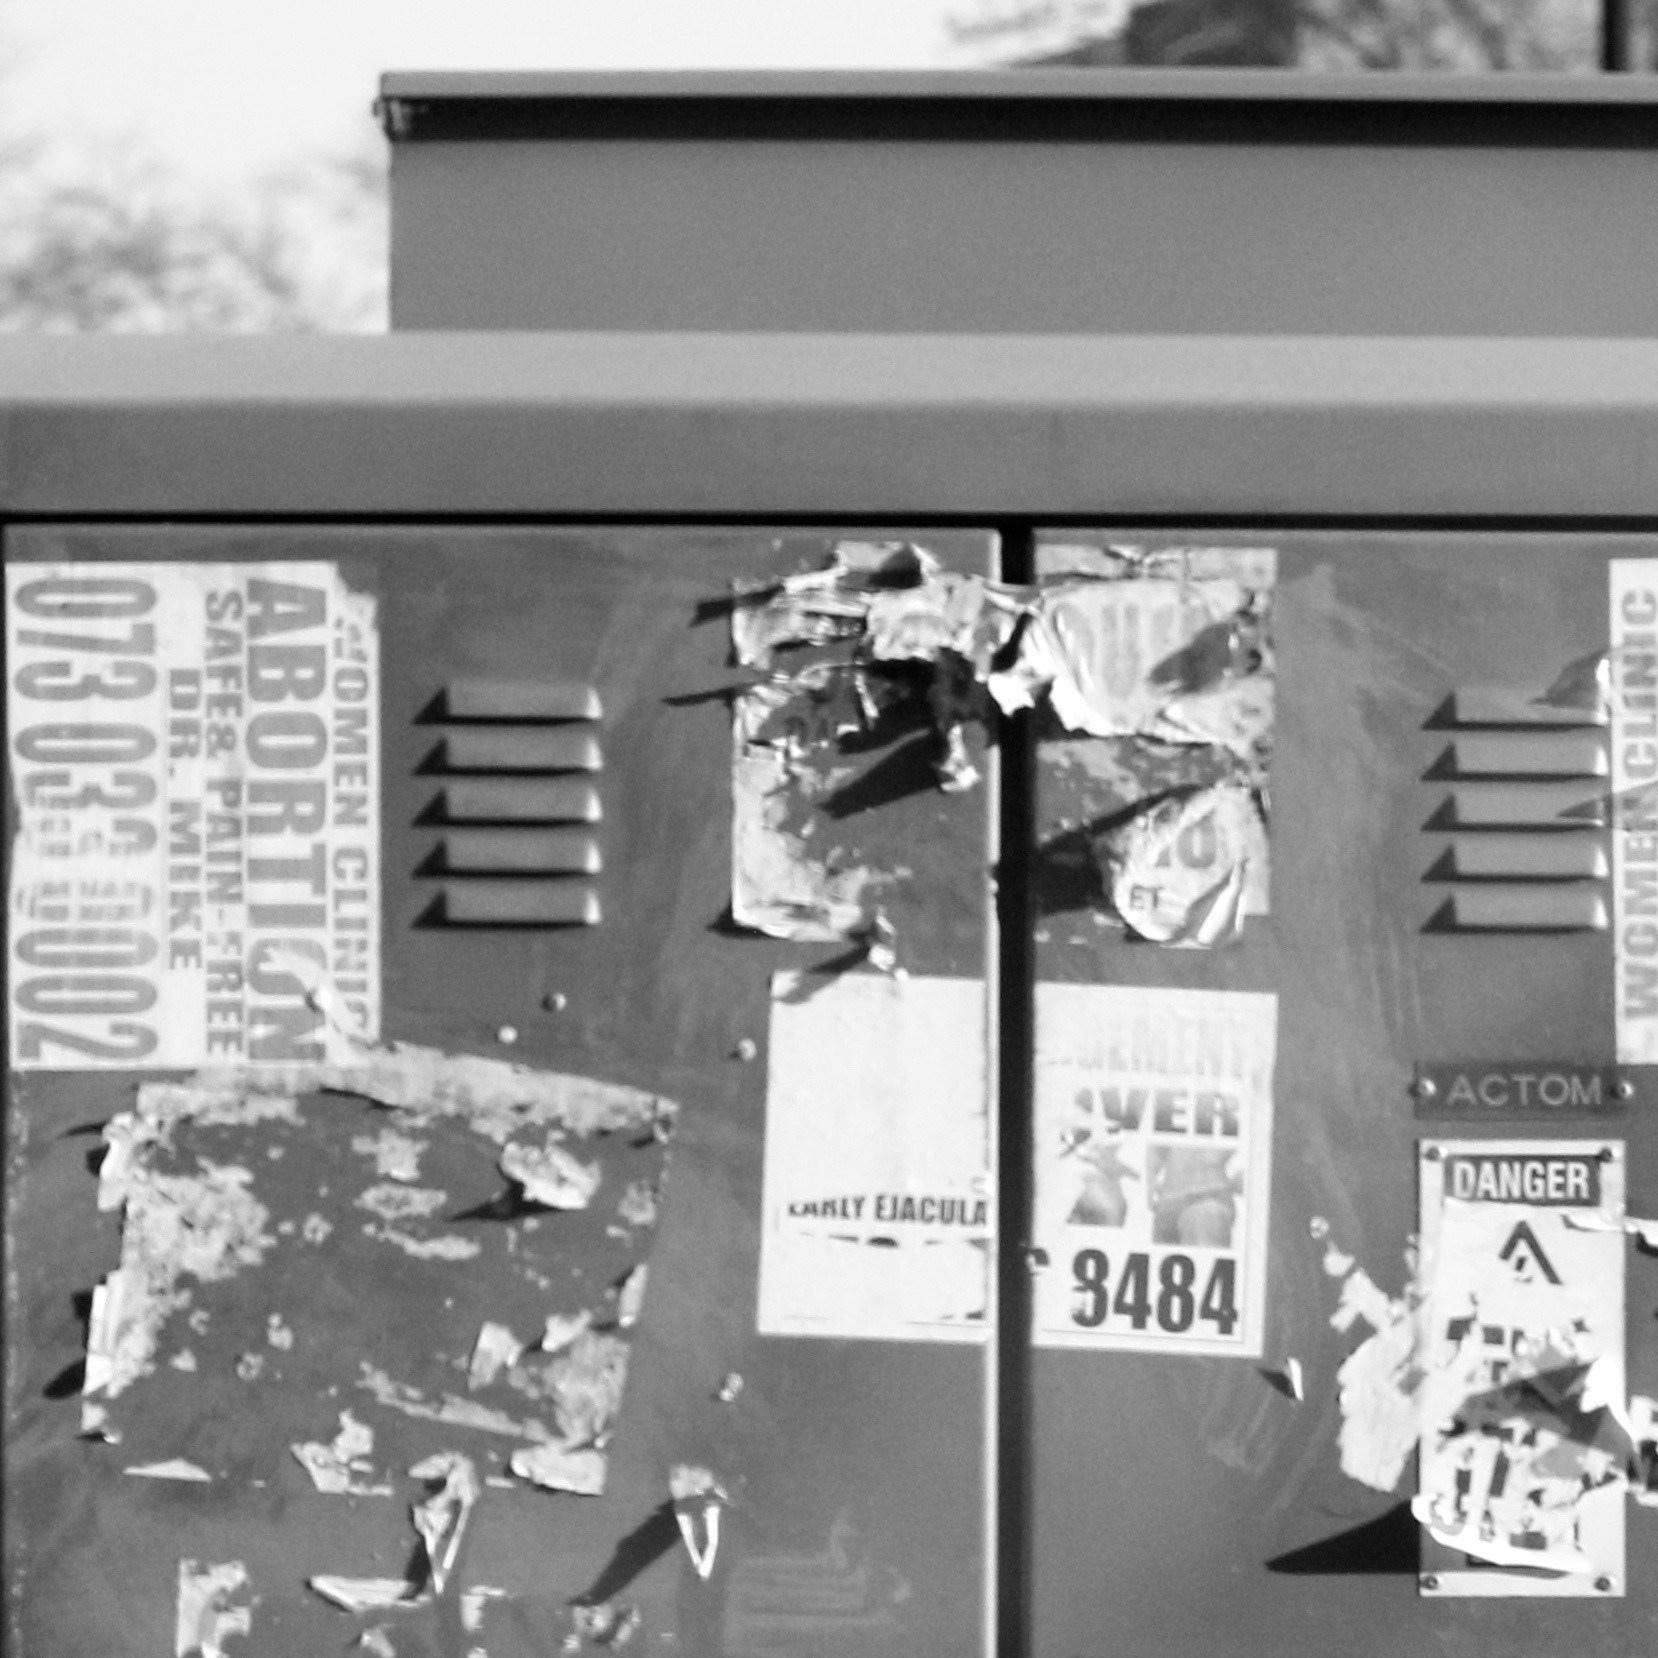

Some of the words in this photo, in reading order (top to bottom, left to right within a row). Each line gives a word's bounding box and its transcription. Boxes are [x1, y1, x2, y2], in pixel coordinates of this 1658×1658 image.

[14, 578, 158, 701] 073
[206, 590, 243, 760] SAFE&
[169, 802, 202, 970] MIKE
[1447, 1074, 1603, 1108] ACTOM
[1452, 1160, 1590, 1200] DANGER
